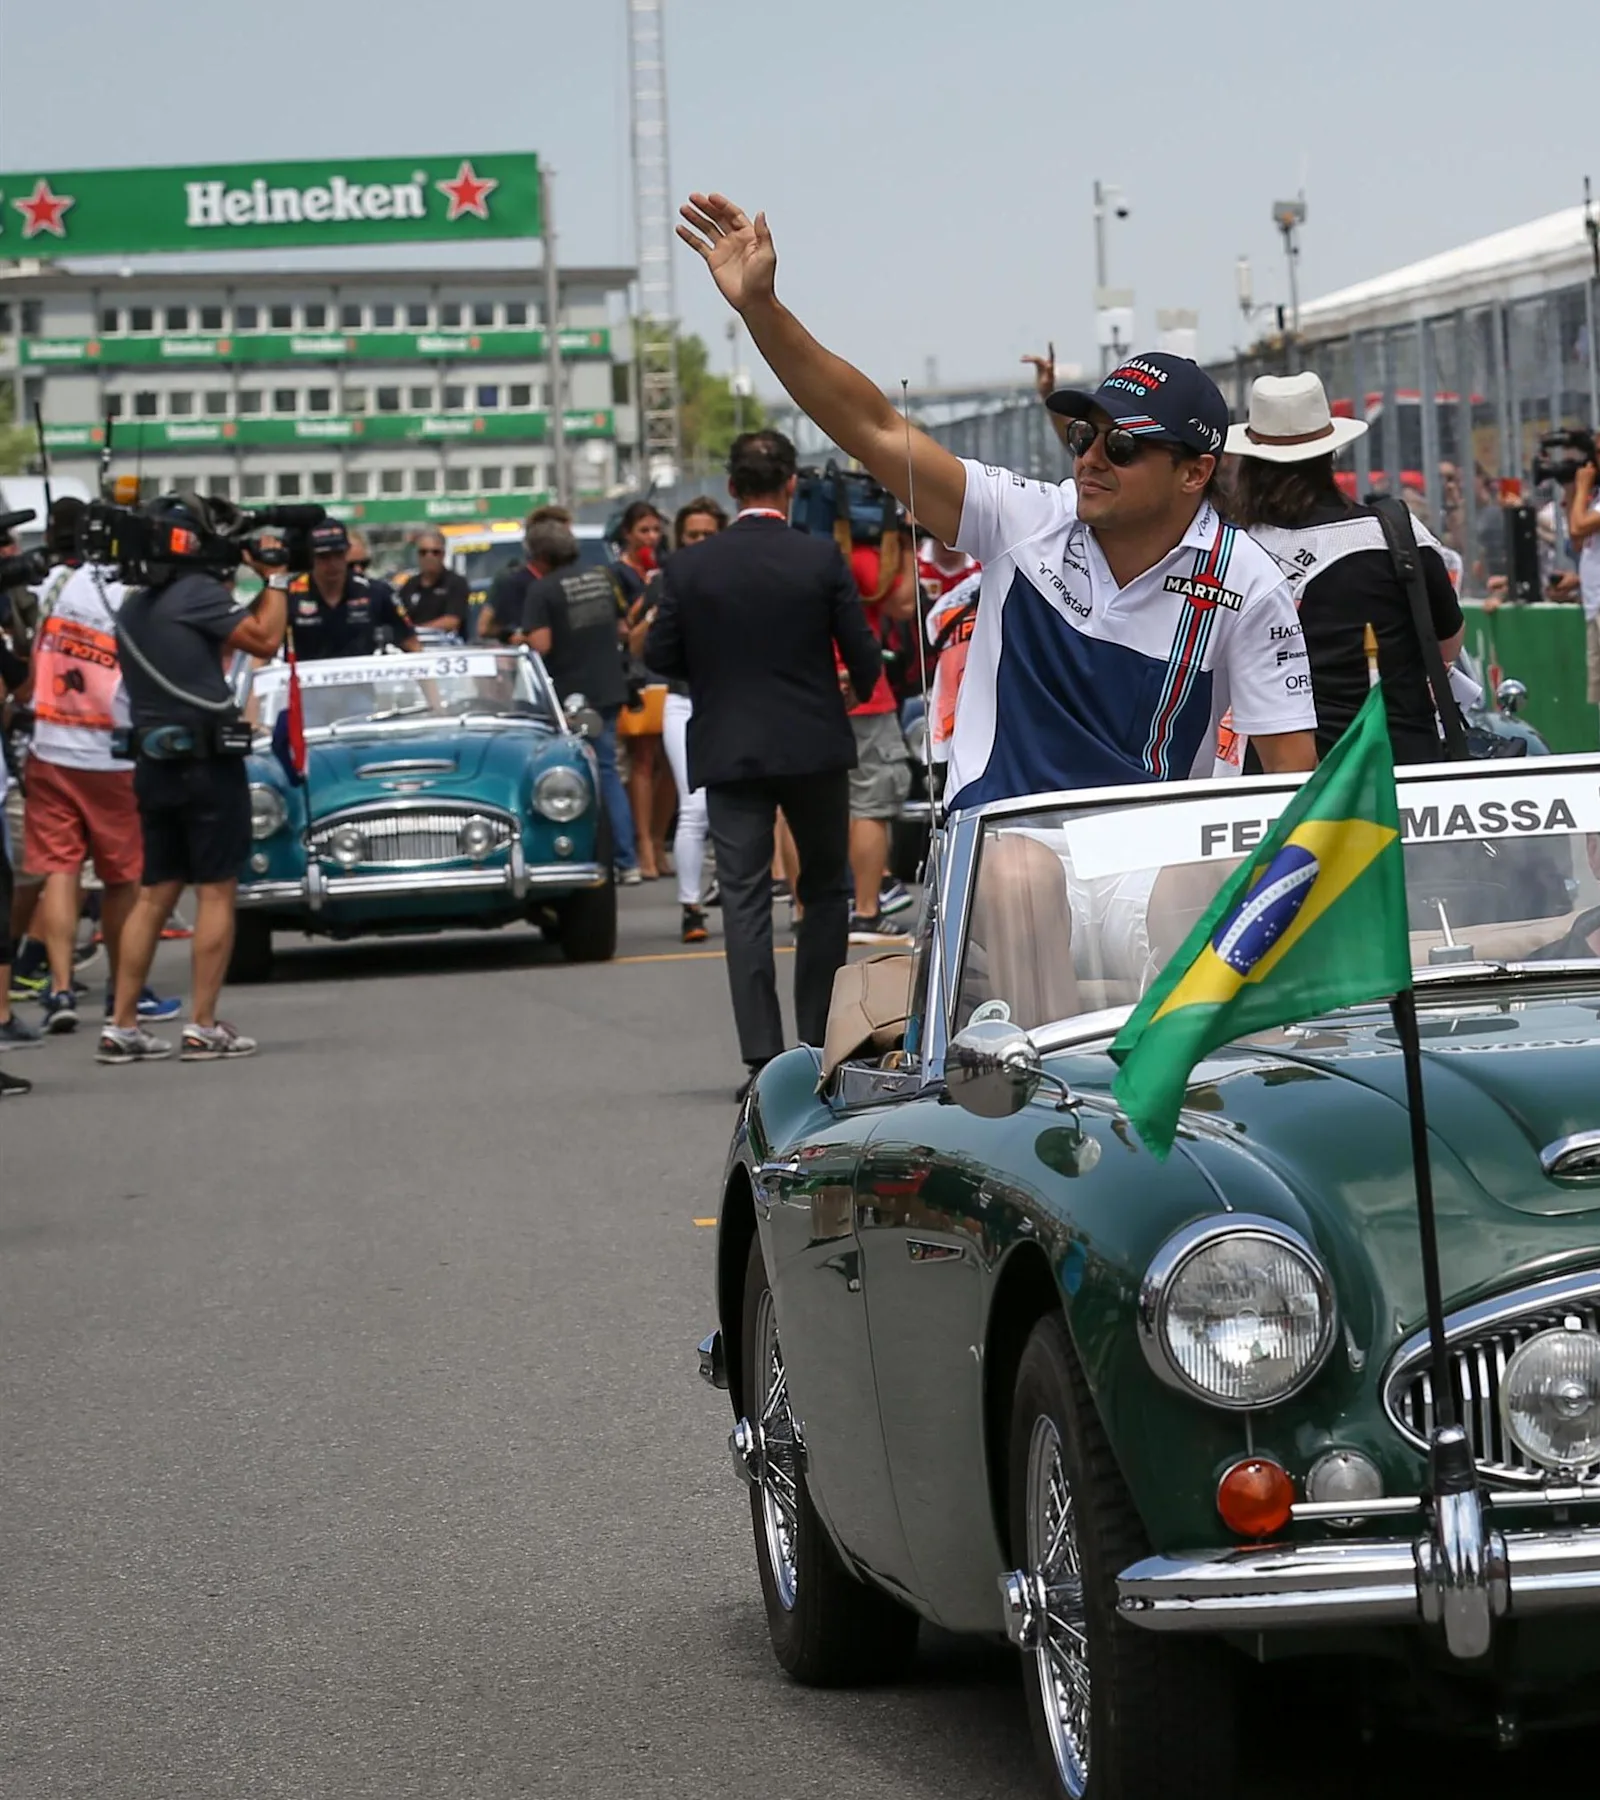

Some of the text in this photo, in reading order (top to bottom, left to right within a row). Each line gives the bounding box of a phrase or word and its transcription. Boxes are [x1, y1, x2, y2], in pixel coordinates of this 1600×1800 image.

[184, 177, 426, 228] Heineken
[1049, 572, 1092, 618] randstad
[1166, 577, 1241, 610] MARTINI
[435, 656, 469, 675] 33
[1398, 799, 1577, 839] MASSA
